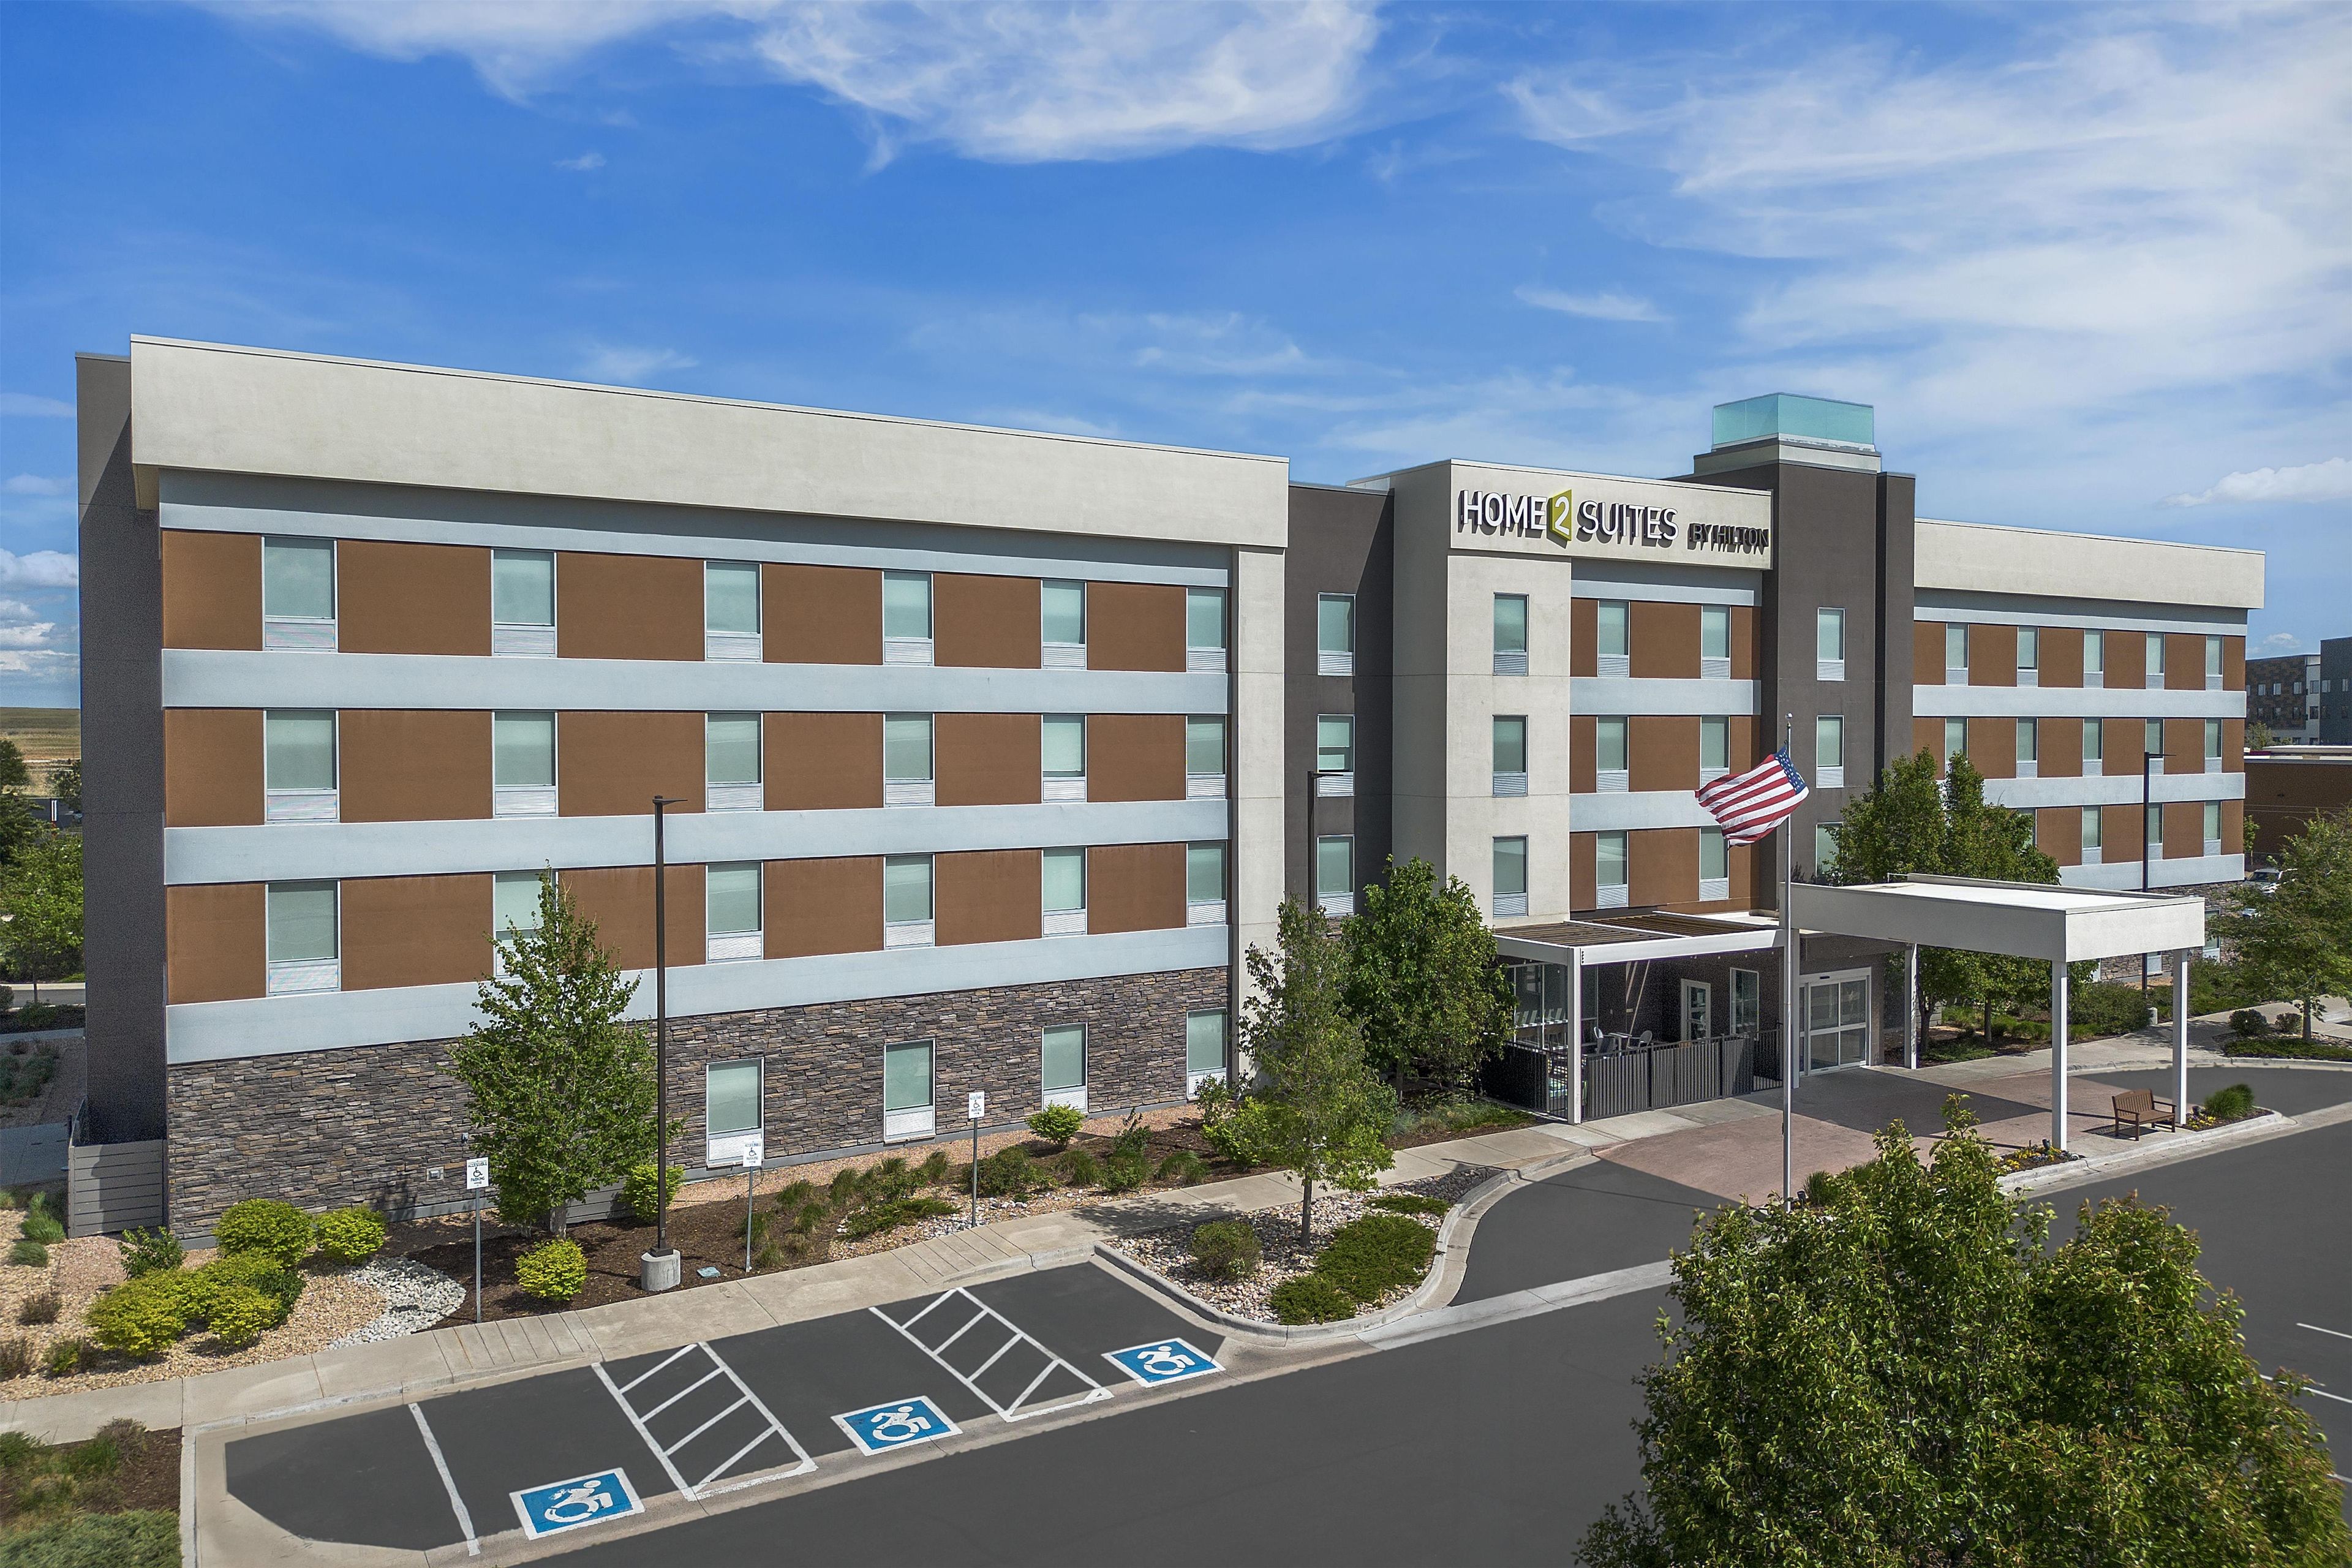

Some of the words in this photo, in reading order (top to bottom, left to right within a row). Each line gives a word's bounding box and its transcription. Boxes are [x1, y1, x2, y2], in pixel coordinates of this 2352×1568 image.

[1580, 500, 1679, 541] SUITES
[1691, 523, 1713, 543] BY
[1715, 525, 1769, 548] HILTON
